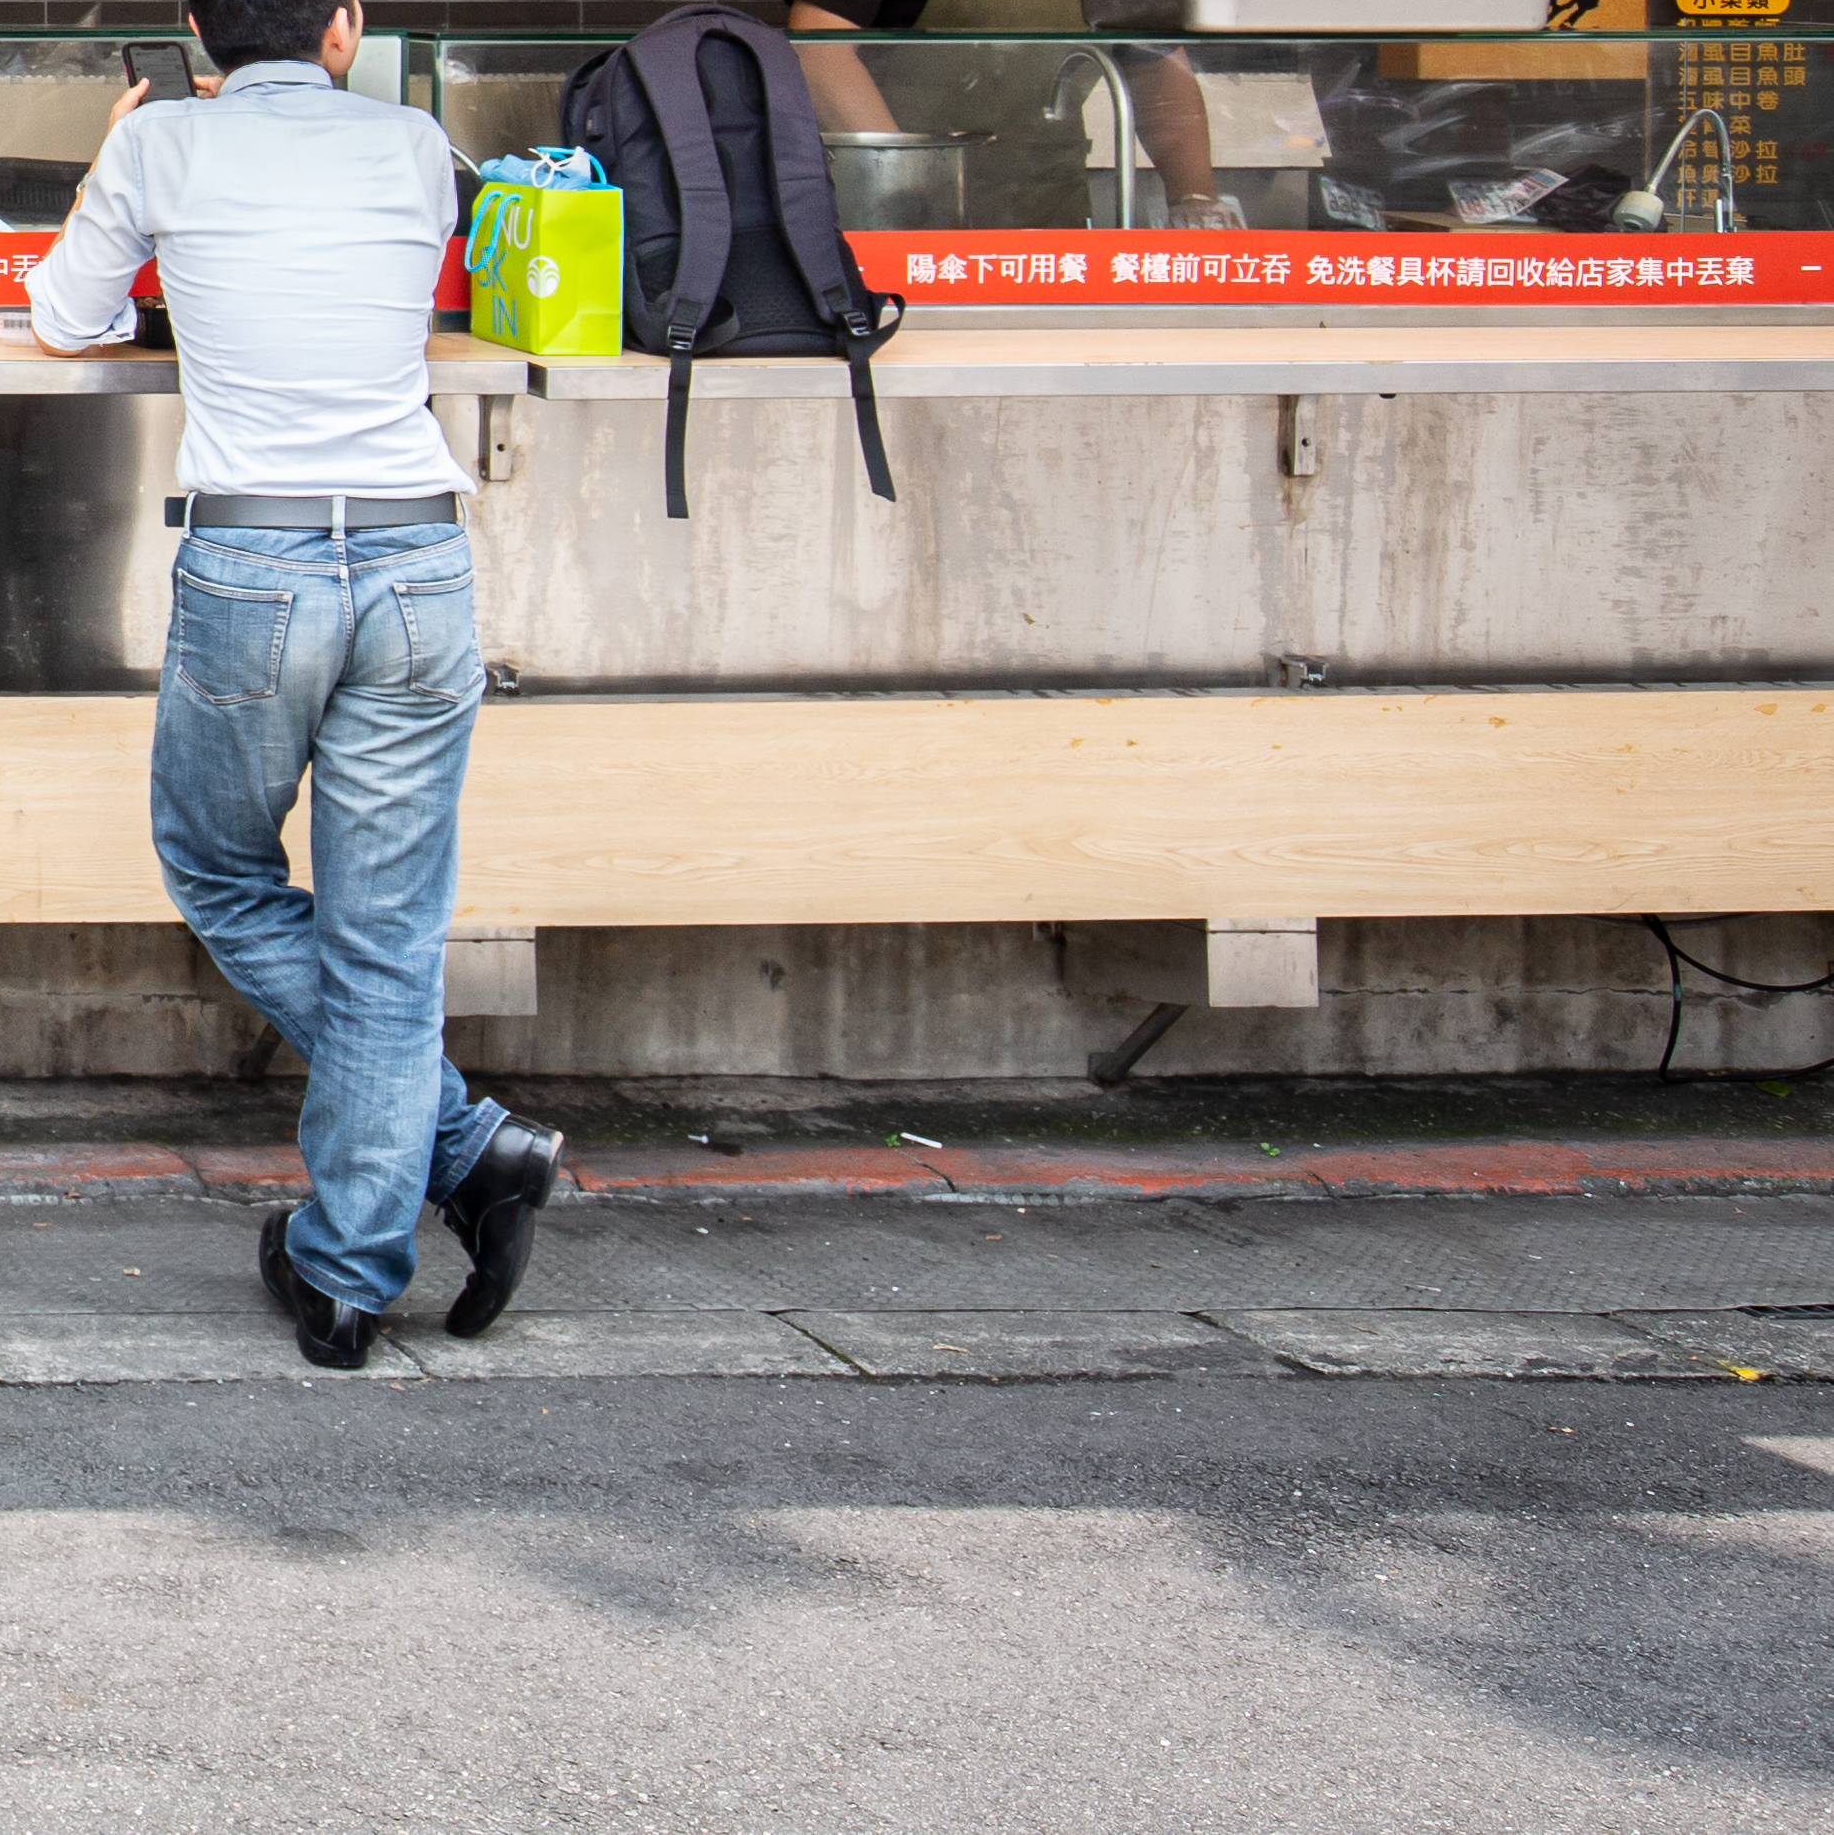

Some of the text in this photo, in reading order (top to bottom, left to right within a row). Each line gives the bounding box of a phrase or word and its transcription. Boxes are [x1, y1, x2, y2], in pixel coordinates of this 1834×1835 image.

[906, 253, 1087, 284] 陽傘下可用餐
[492, 294, 517, 339] IN
